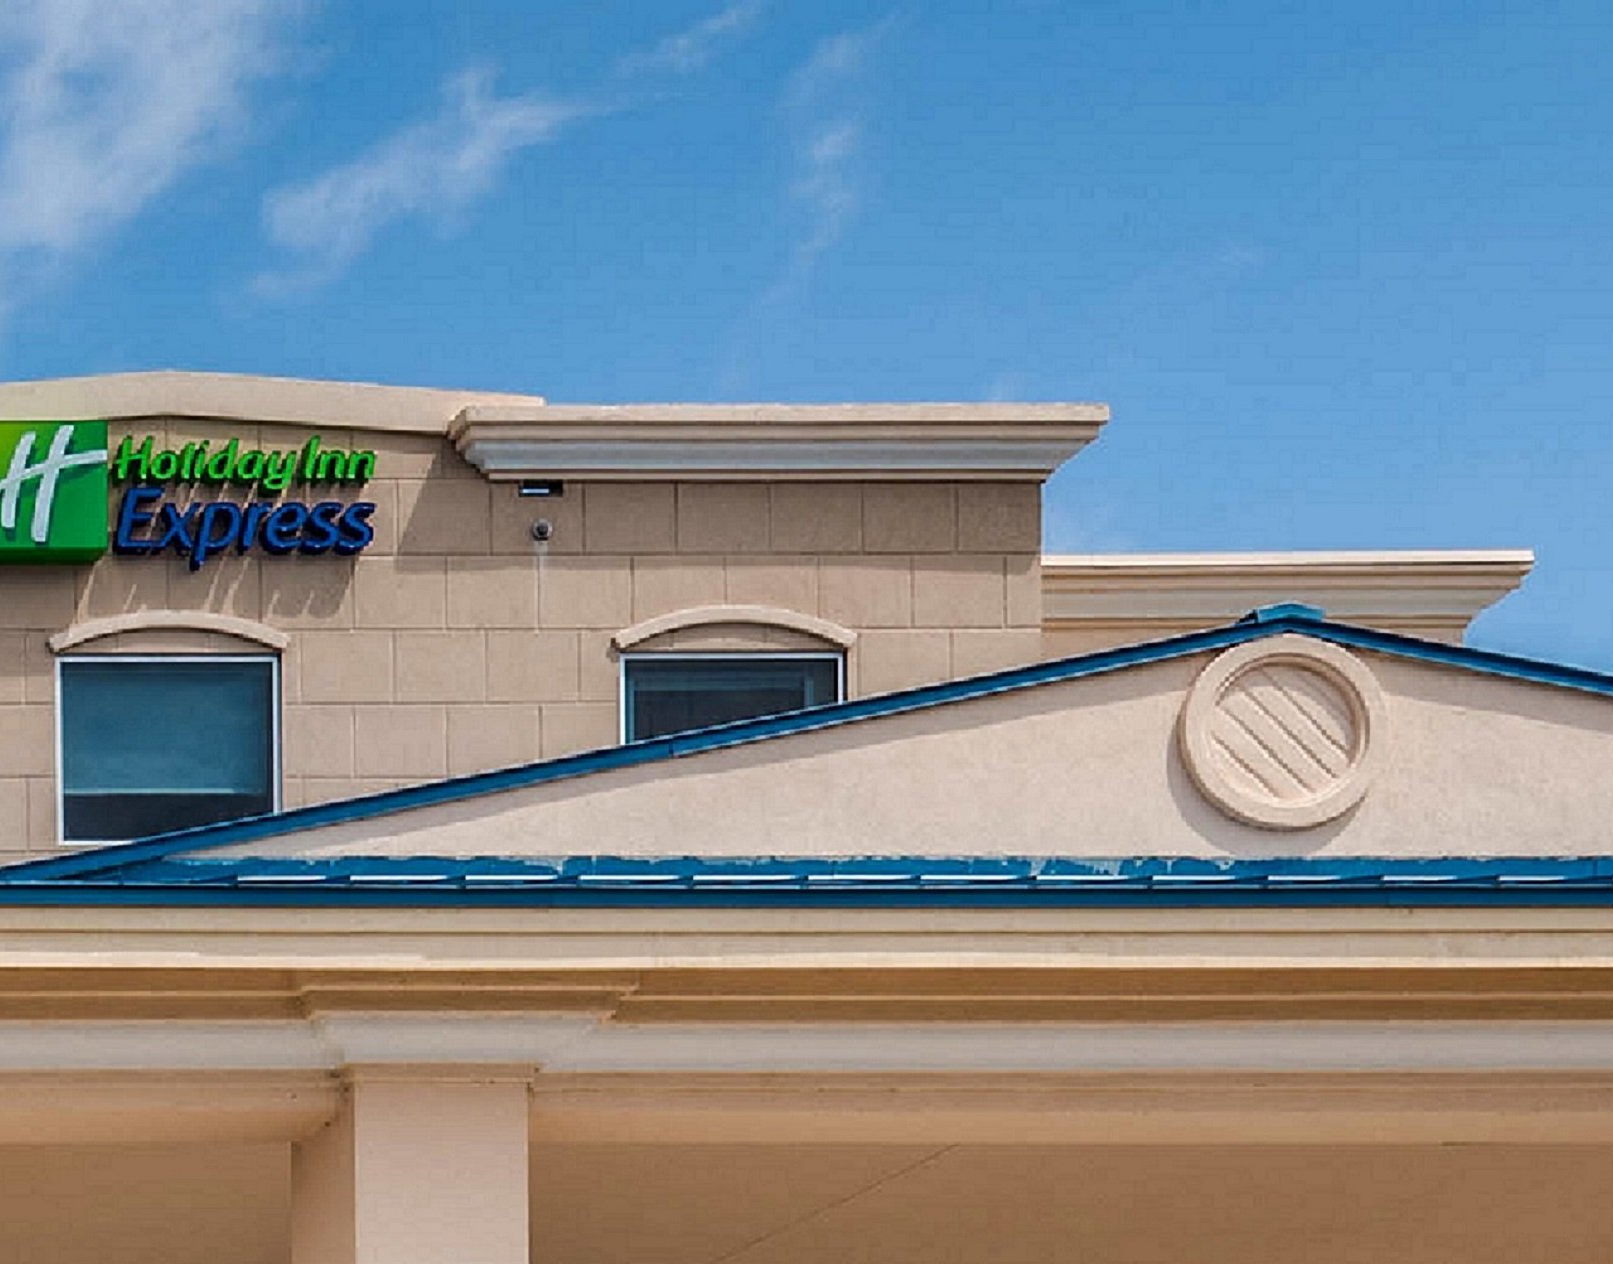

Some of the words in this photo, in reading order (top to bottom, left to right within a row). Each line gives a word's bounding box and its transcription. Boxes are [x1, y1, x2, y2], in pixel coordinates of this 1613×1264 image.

[117, 434, 296, 490] Holiday
[303, 434, 377, 481] Inn
[114, 487, 377, 569] Express
